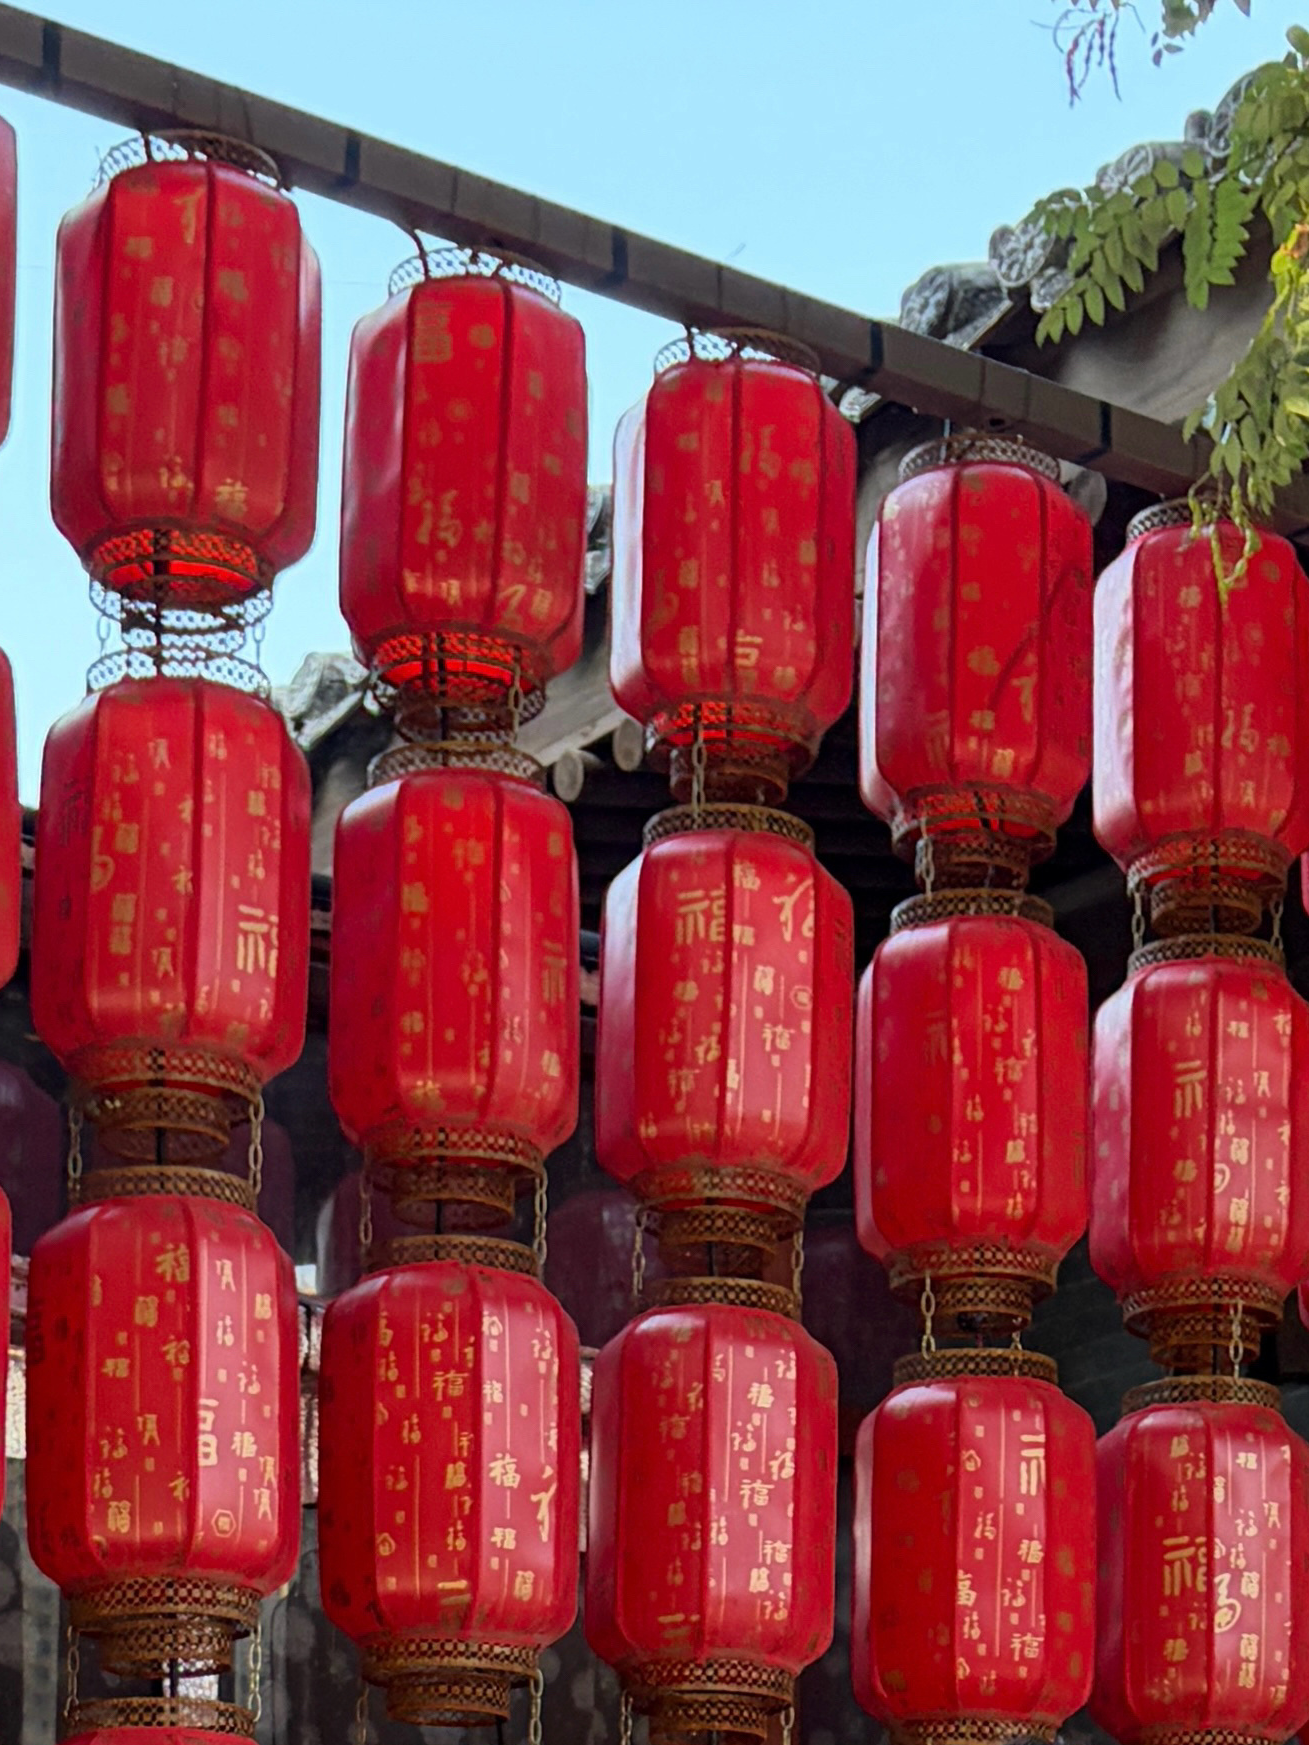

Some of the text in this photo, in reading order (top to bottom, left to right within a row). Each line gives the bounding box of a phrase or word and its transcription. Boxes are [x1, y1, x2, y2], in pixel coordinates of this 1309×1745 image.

[433, 1370, 467, 1401] 福
[488, 1453, 520, 1488] 福
[740, 1480, 773, 1509] 福
[1010, 1633, 1041, 1661] 福
